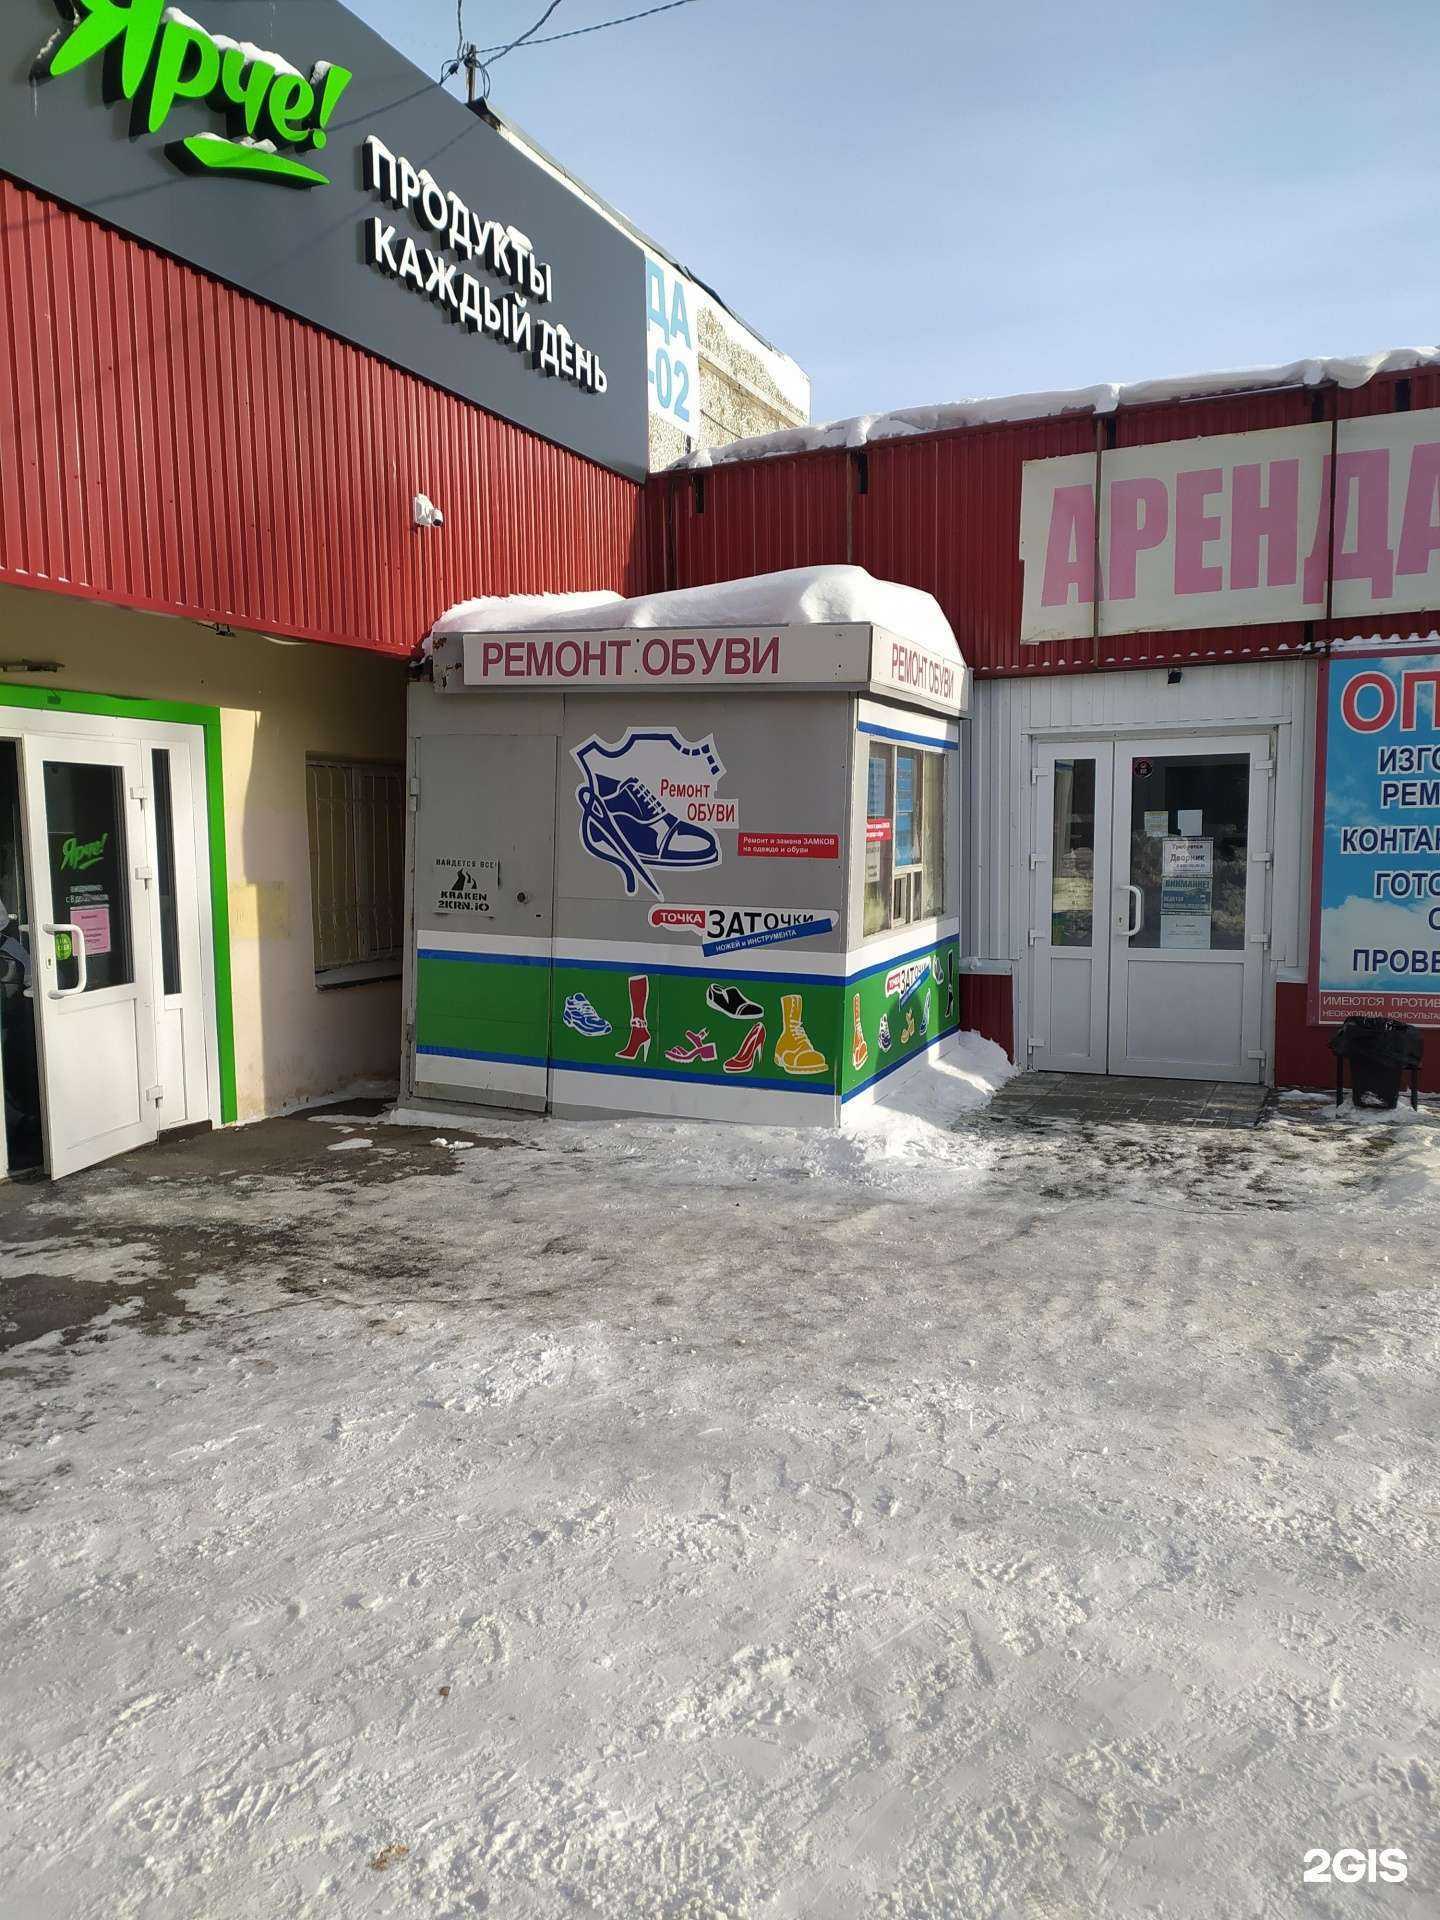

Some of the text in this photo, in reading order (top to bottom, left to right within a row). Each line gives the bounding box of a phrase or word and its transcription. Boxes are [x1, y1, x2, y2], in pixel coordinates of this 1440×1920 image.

[370, 137, 553, 303] ПРОДУКТЫ
[374, 215, 608, 393] КАЖДЫЙ ДЕНЬ
[1041, 443, 1440, 607] АРЕНДА
[482, 636, 781, 678] РЕМОНТ ОБУВИ
[891, 643, 954, 699] РЕМОНТ ОБУВИ
[659, 778, 711, 798] Ремонт
[1382, 782, 1440, 807] РЕМ
[687, 802, 736, 823] ОБУВИ
[743, 836, 769, 845] Ремонт
[776, 838, 802, 846] замена
[803, 837, 835, 847] ЗАМКОВ
[786, 845, 809, 854] обуви
[1341, 826, 1440, 853] КОНТА
[440, 890, 487, 901] KRAKEN
[659, 911, 704, 924] ТОЧКА
[706, 909, 815, 938] ЗАТОЧКИ
[715, 940, 741, 952] НОЖЕЙ
[747, 929, 798, 947] ИНСТРУМЕНТА
[1322, 996, 1440, 1008] ИМЕЮТСЯ ПРОТИВ
